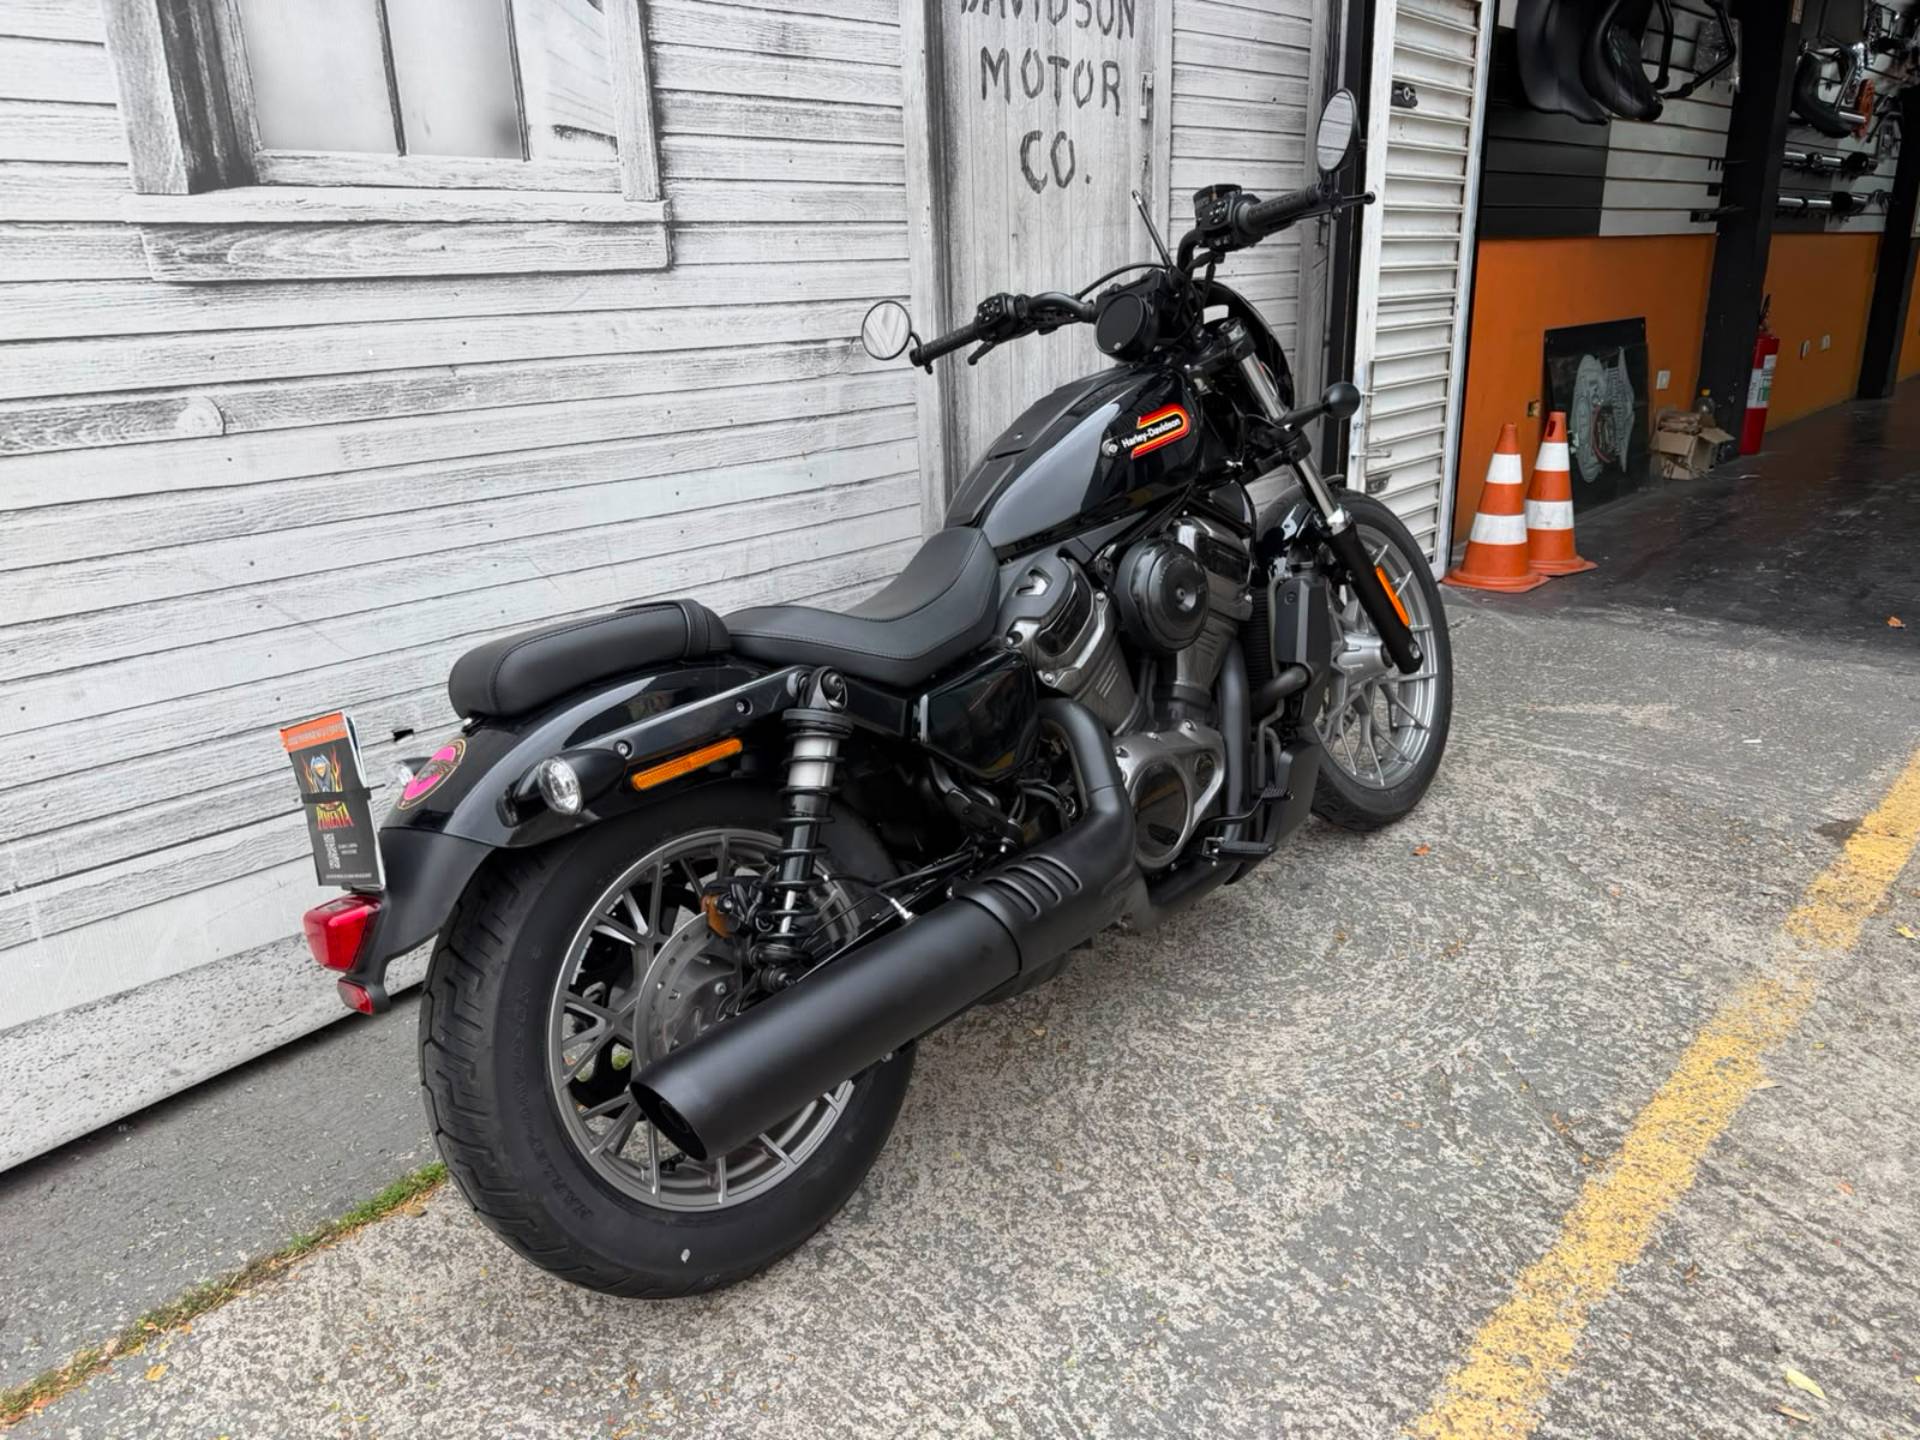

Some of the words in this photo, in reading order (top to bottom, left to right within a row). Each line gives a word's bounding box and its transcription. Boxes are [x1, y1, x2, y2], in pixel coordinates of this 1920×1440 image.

[980, 46, 1122, 117] MOTOR
[1020, 129, 1093, 194] CO.
[1121, 418, 1182, 449] Harley-Davidson
